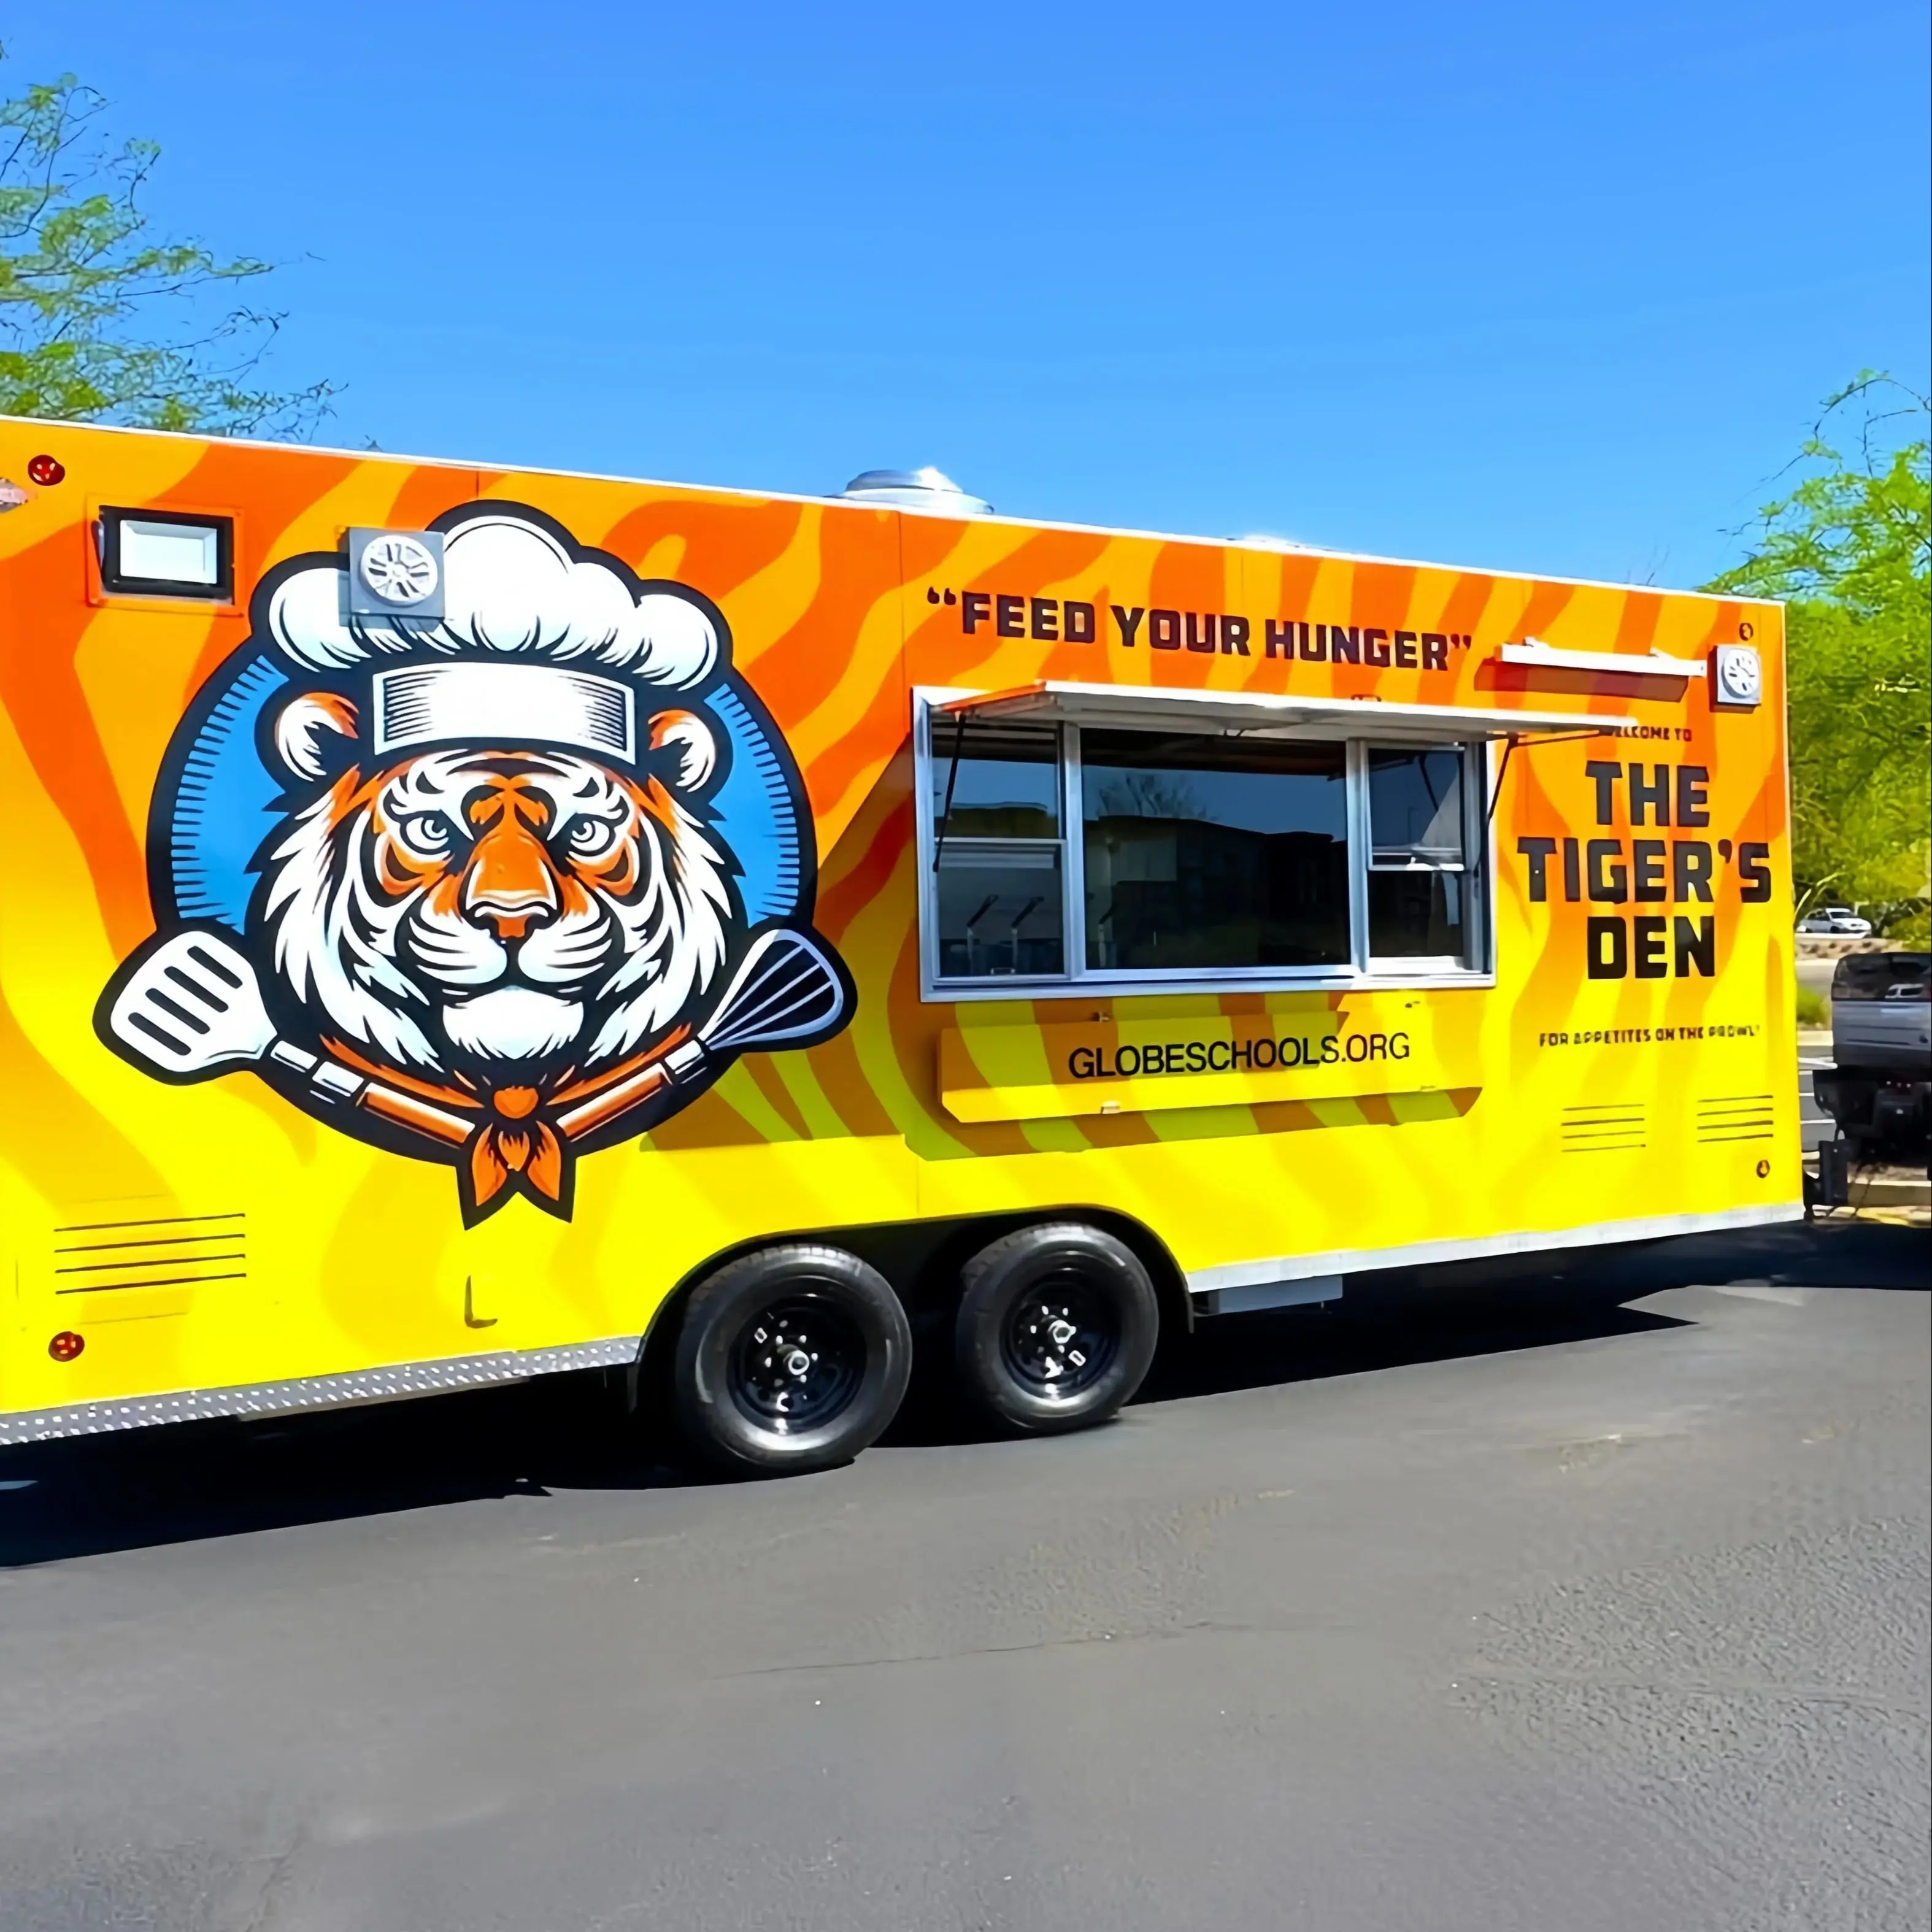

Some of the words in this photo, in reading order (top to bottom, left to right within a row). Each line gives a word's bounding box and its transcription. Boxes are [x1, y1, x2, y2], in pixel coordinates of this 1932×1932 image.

[926, 586, 1096, 644] “FEED
[1109, 605, 1252, 656] YOUR
[1265, 618, 1472, 671] HUNGER”
[1601, 725, 1670, 741] ELCOME
[1674, 728, 1692, 742] TO
[1585, 760, 1710, 827] THE
[1517, 836, 1772, 904] TIGER'S
[1587, 915, 1715, 980] DEN
[1068, 1032, 1410, 1079] GLOBESCHOOLS.ORG
[1539, 1033, 1568, 1047] FOR
[1574, 1029, 1651, 1044] APPETITES
[1655, 1028, 1675, 1042] ON
[1679, 1026, 1704, 1040] THE
